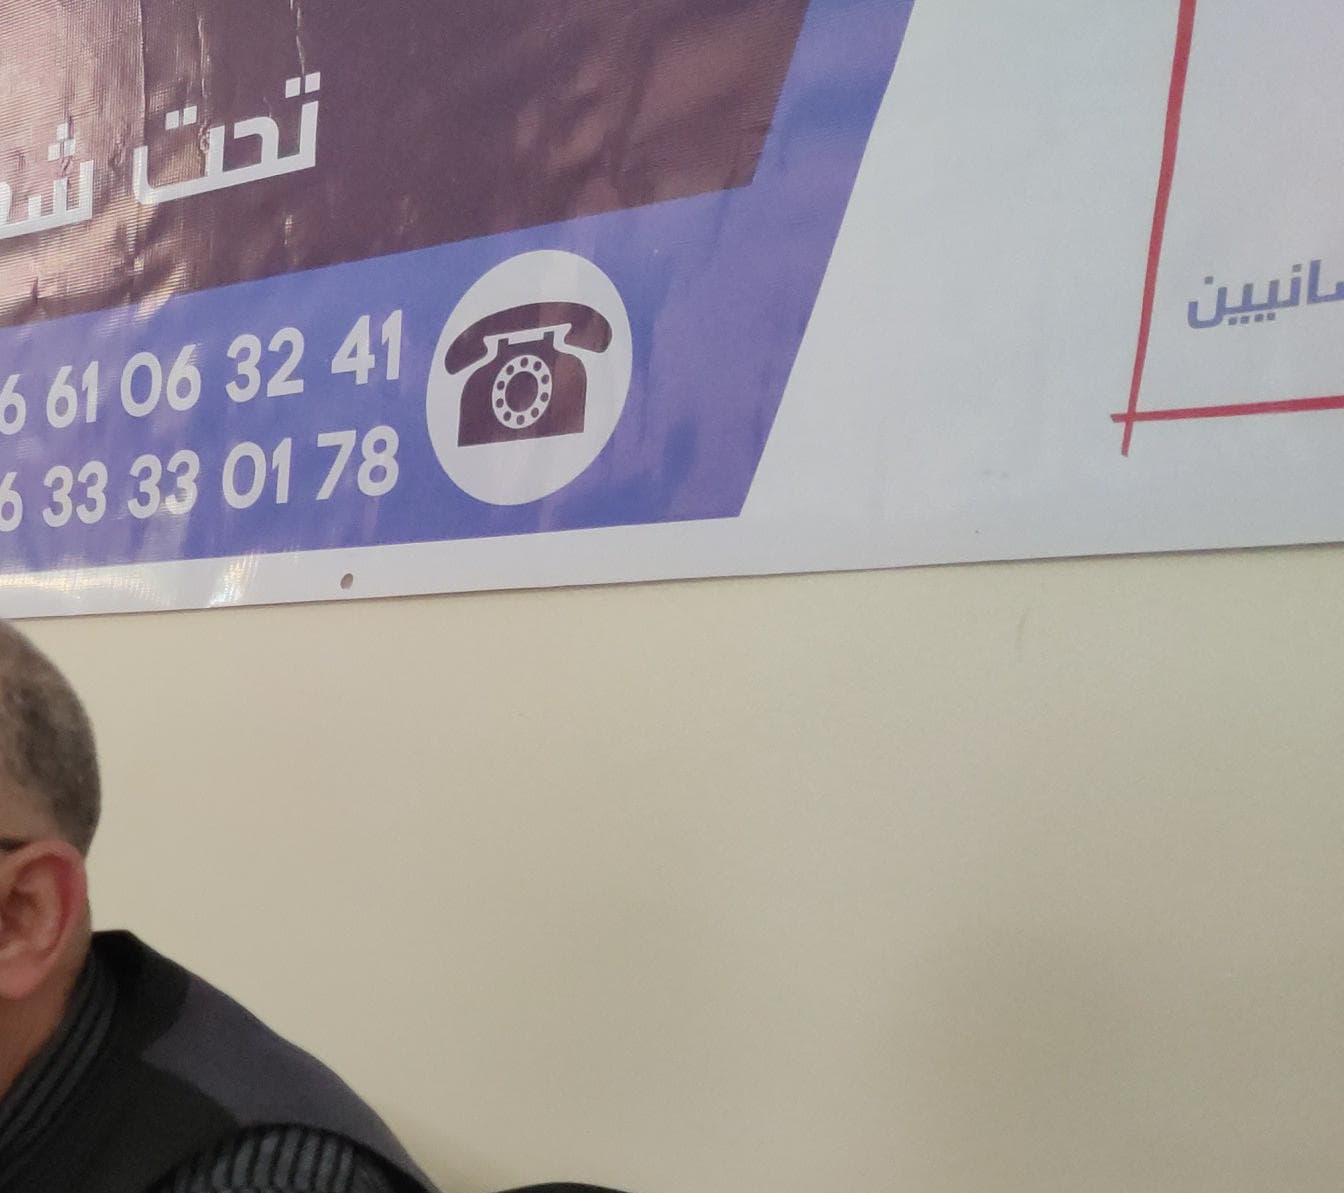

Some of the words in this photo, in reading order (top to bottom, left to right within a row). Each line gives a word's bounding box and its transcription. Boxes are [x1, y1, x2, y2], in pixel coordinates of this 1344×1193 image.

[132, 72, 321, 206] تحت
[1187, 259, 1344, 329] انيين
[45, 360, 100, 429] 61
[120, 344, 202, 418] 06
[225, 327, 305, 403] 32
[331, 309, 403, 385] 41
[42, 460, 108, 528] 33
[127, 450, 200, 519] 33
[222, 437, 292, 509] 01
[316, 425, 400, 501] 78
